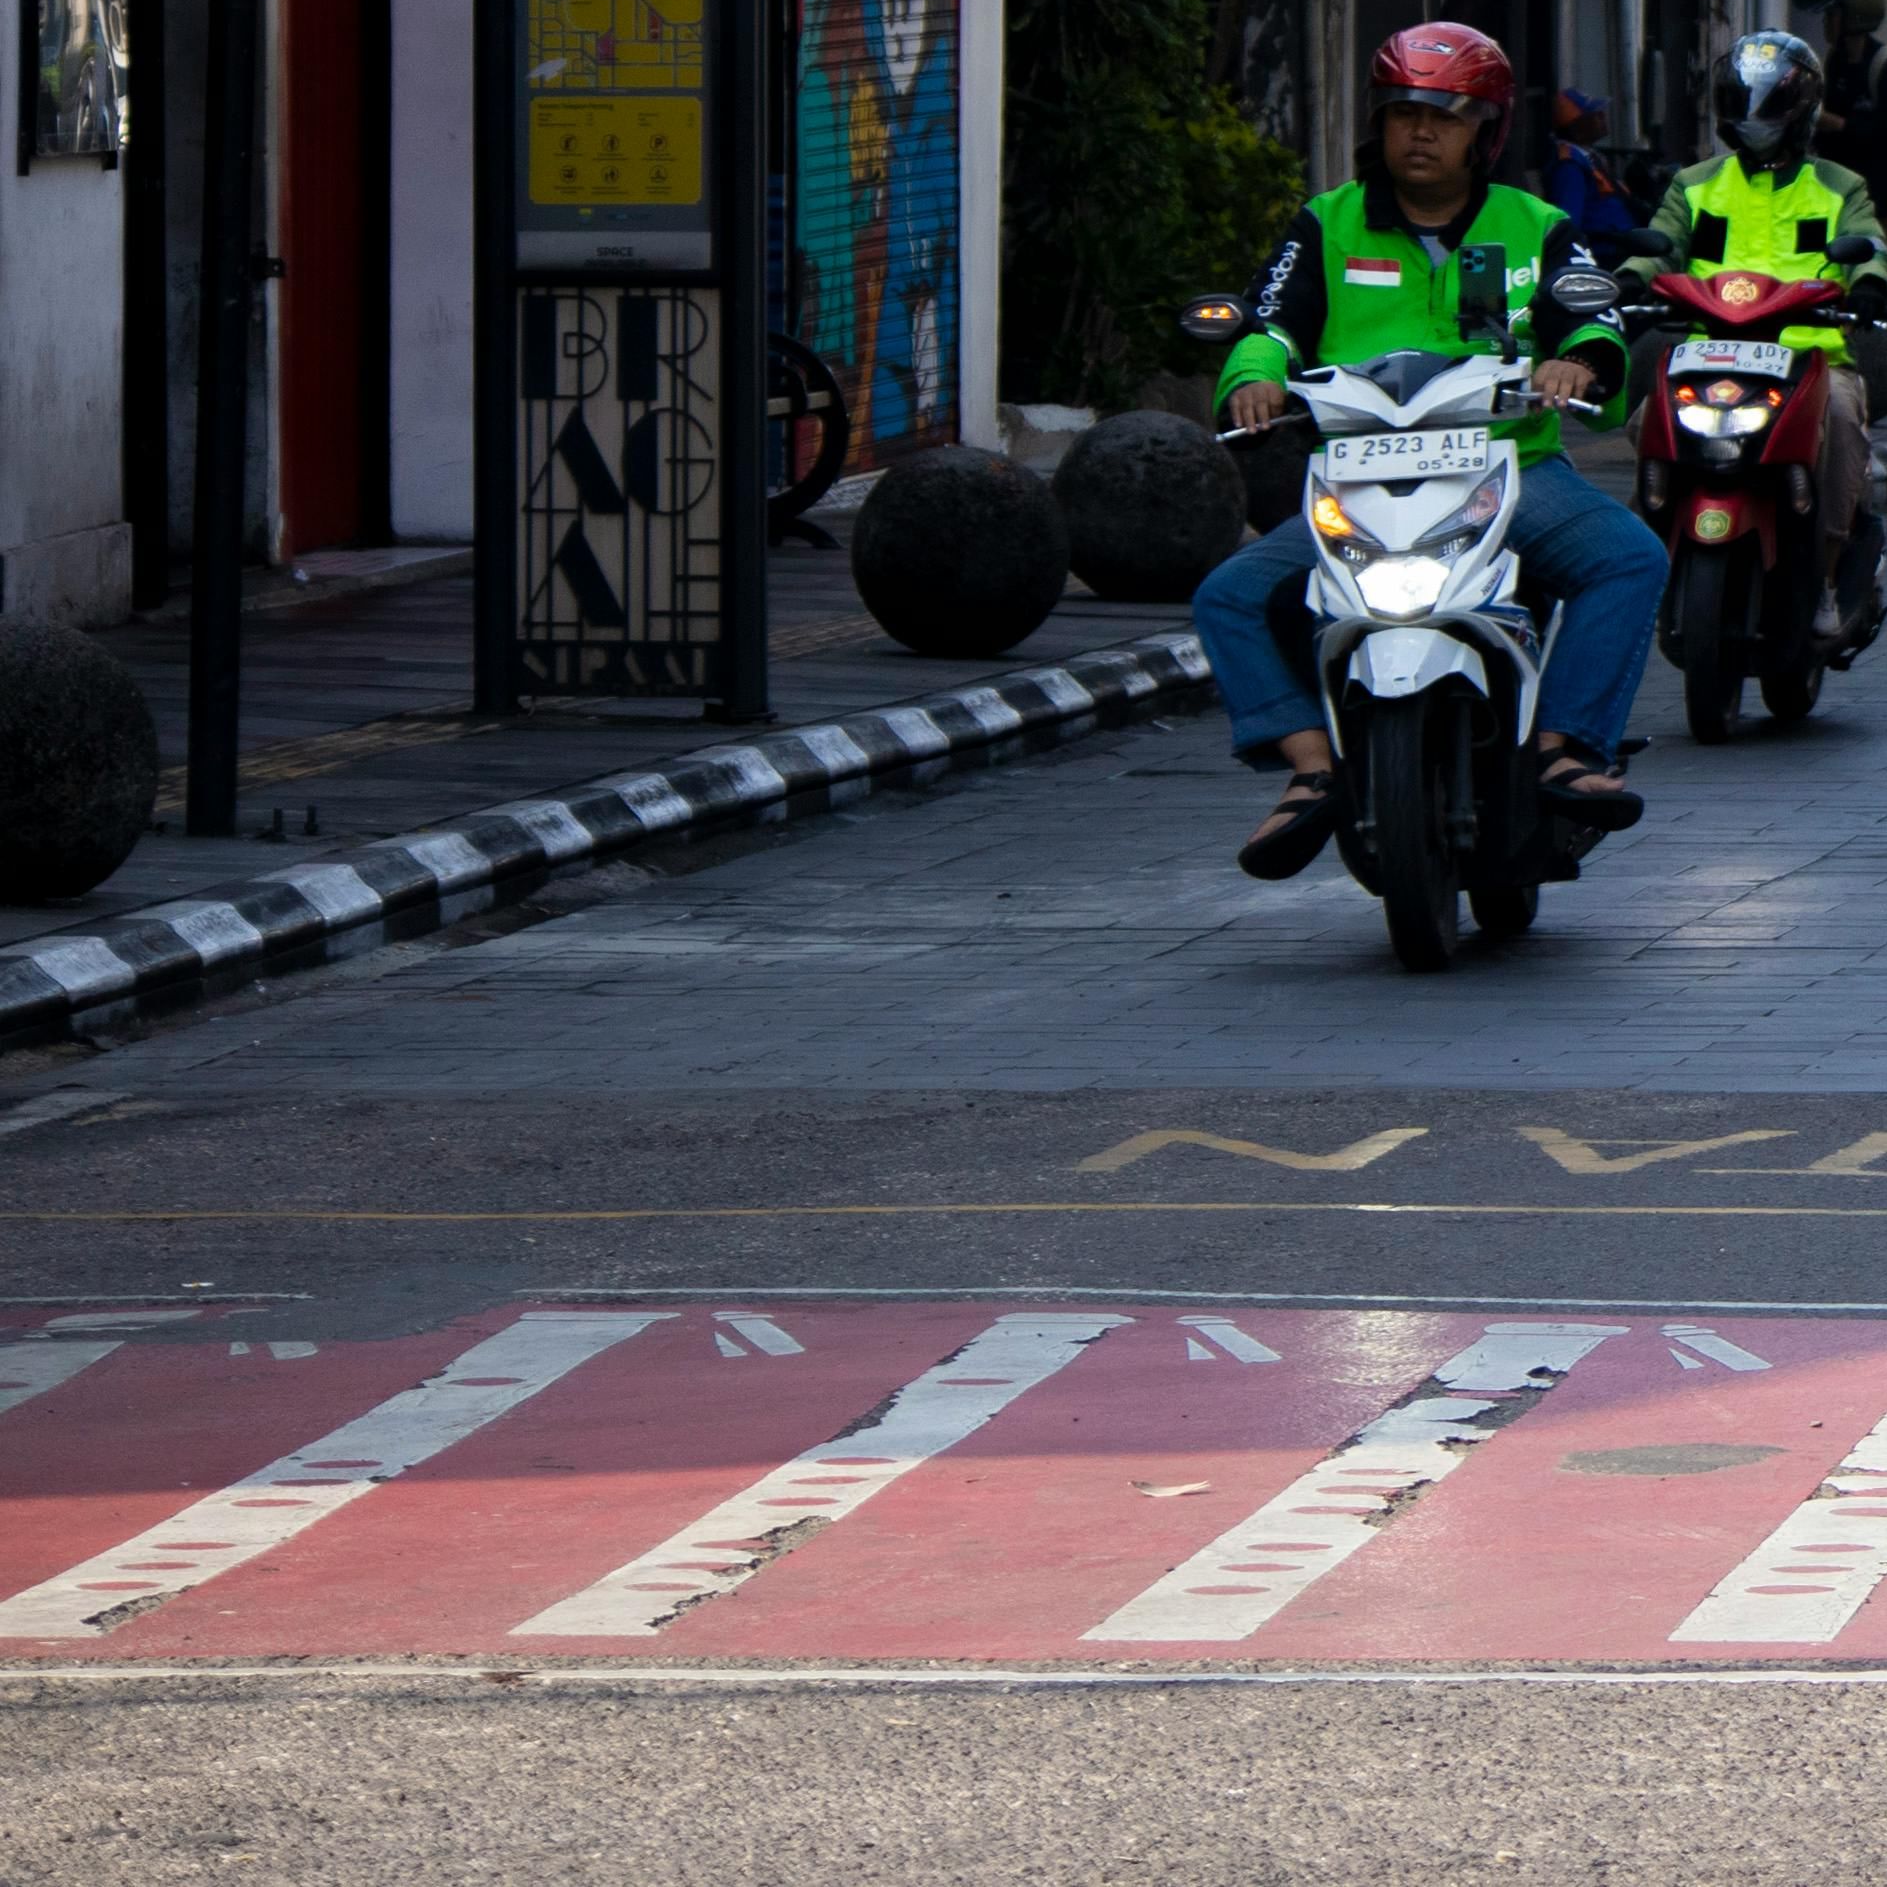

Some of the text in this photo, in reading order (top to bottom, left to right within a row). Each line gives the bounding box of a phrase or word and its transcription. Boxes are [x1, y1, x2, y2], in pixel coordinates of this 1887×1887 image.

[1695, 342, 1743, 356] 2537
[1361, 437, 1424, 458] 2523
[1440, 429, 1487, 452] ALF
